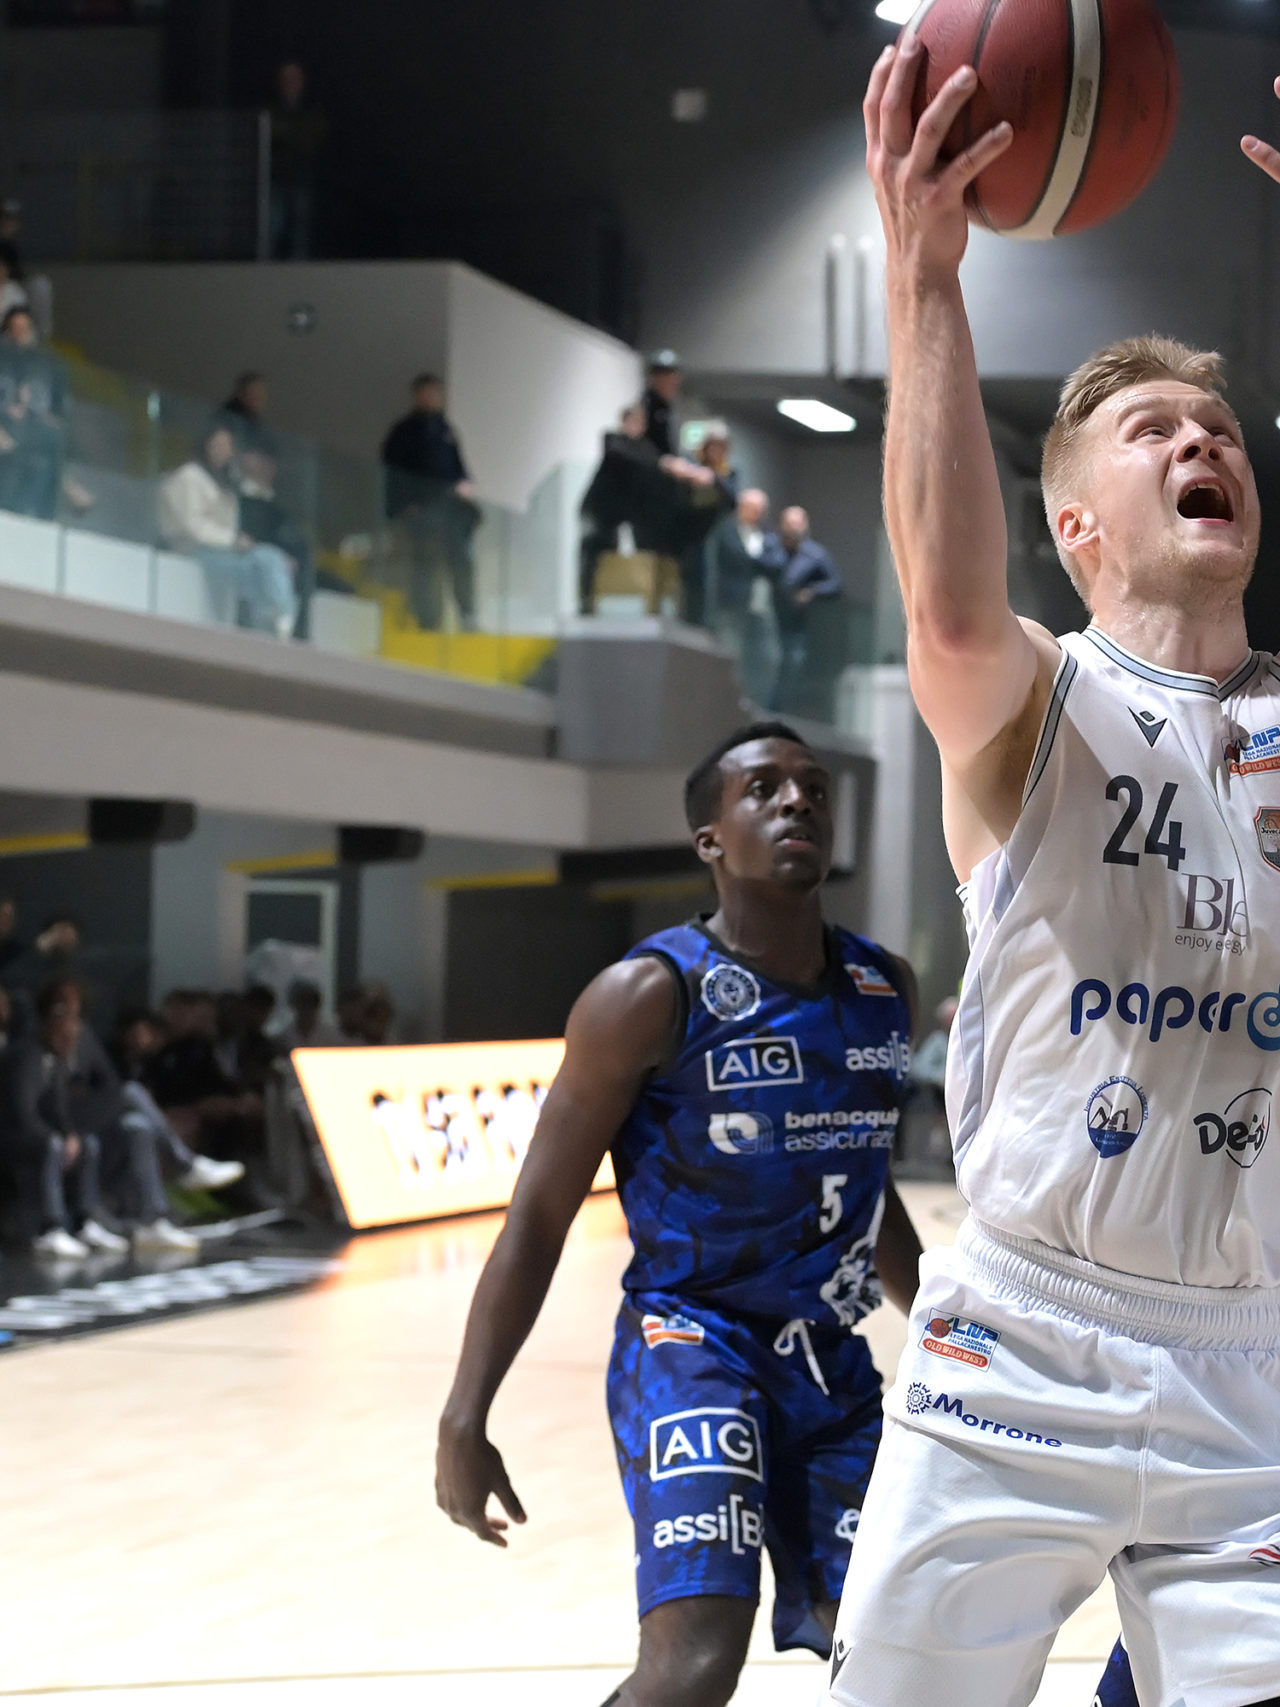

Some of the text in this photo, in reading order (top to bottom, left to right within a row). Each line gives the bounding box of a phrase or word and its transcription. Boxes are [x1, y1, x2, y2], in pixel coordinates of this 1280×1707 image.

[1102, 774, 1186, 872] 24
[1174, 933, 1213, 952] enjoy
[719, 1046, 791, 1081] AIG
[819, 1174, 848, 1234] 5
[952, 1317, 999, 1342] LNP
[926, 1340, 986, 1365] OLD WILD WEST
[932, 1392, 1063, 1448] Morrone
[661, 1420, 754, 1466] AIG
